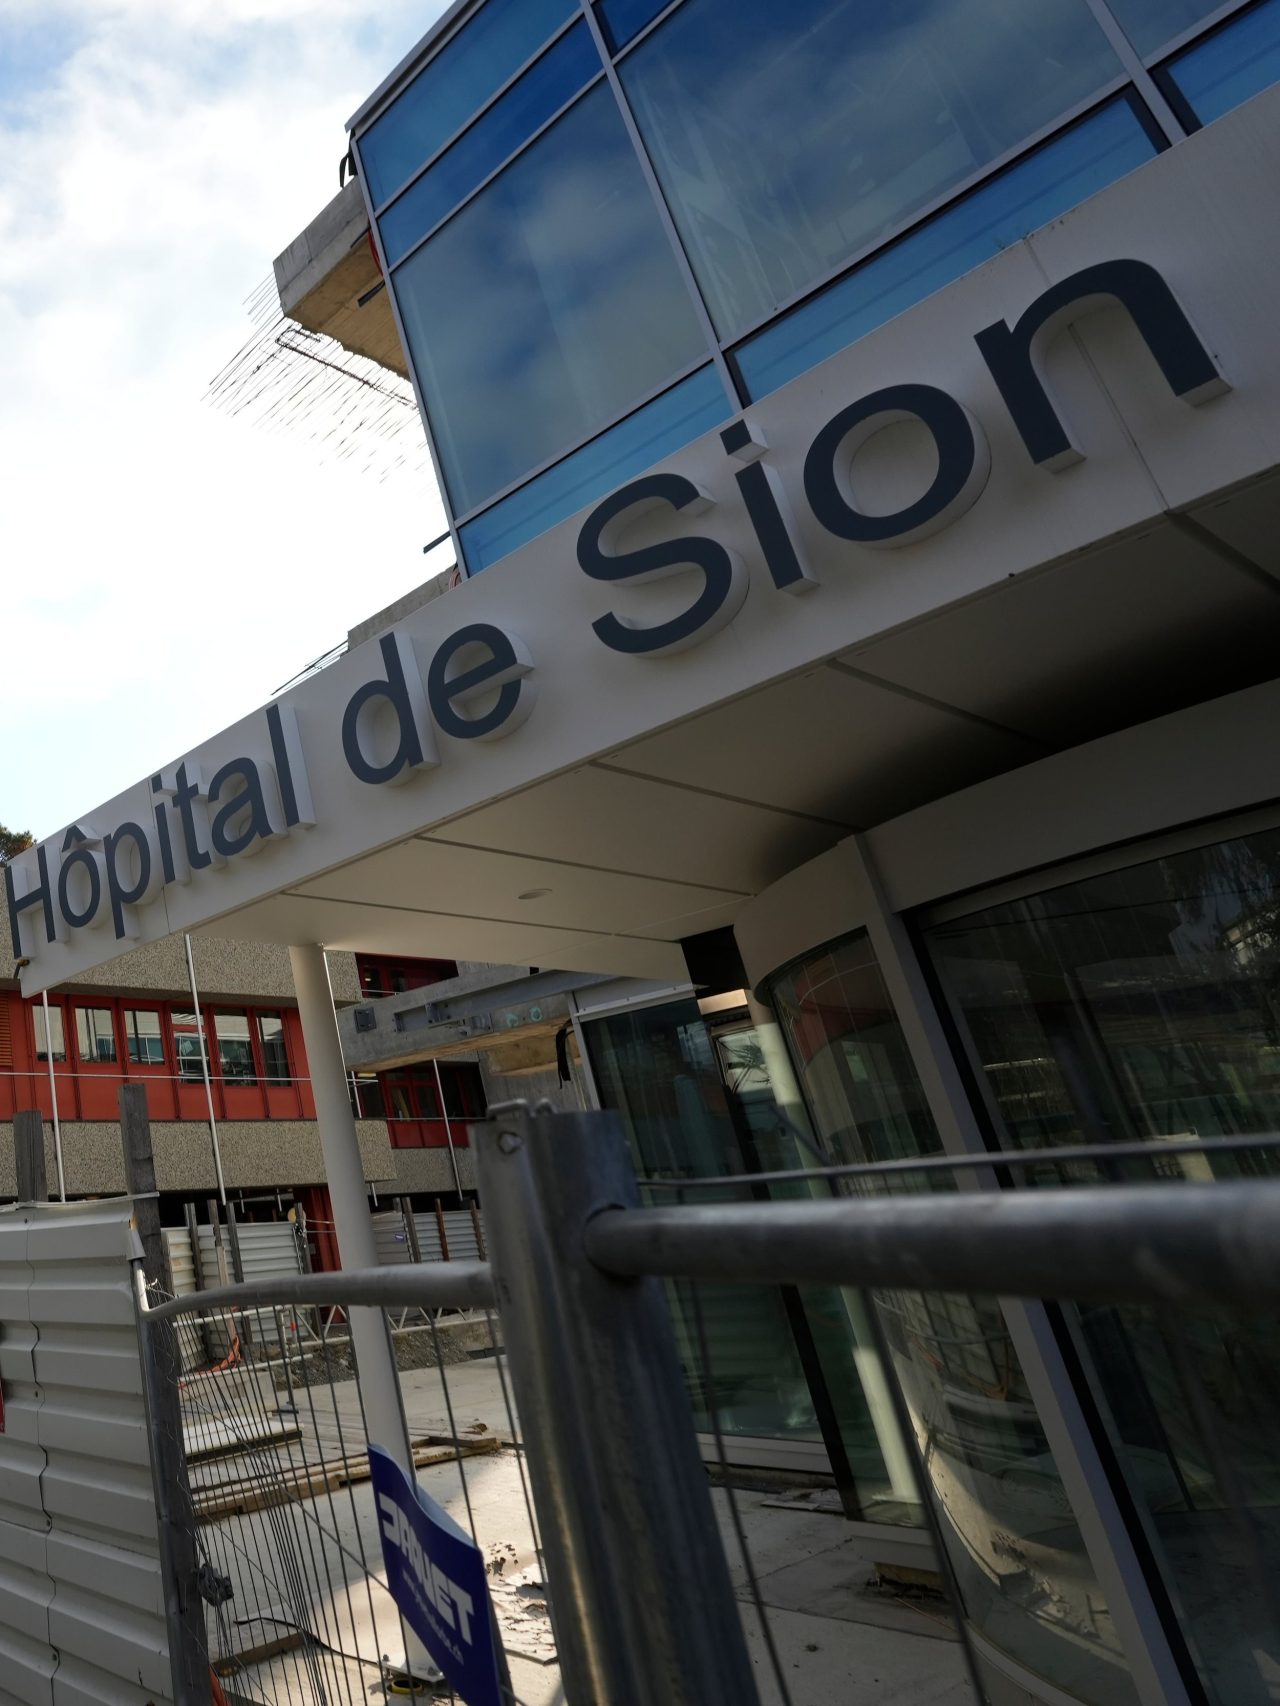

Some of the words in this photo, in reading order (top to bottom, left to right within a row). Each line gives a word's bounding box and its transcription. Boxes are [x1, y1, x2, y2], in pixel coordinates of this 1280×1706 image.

[5, 703, 310, 960] Hôpital
[341, 622, 524, 785] de
[576, 258, 1224, 654] Sion
